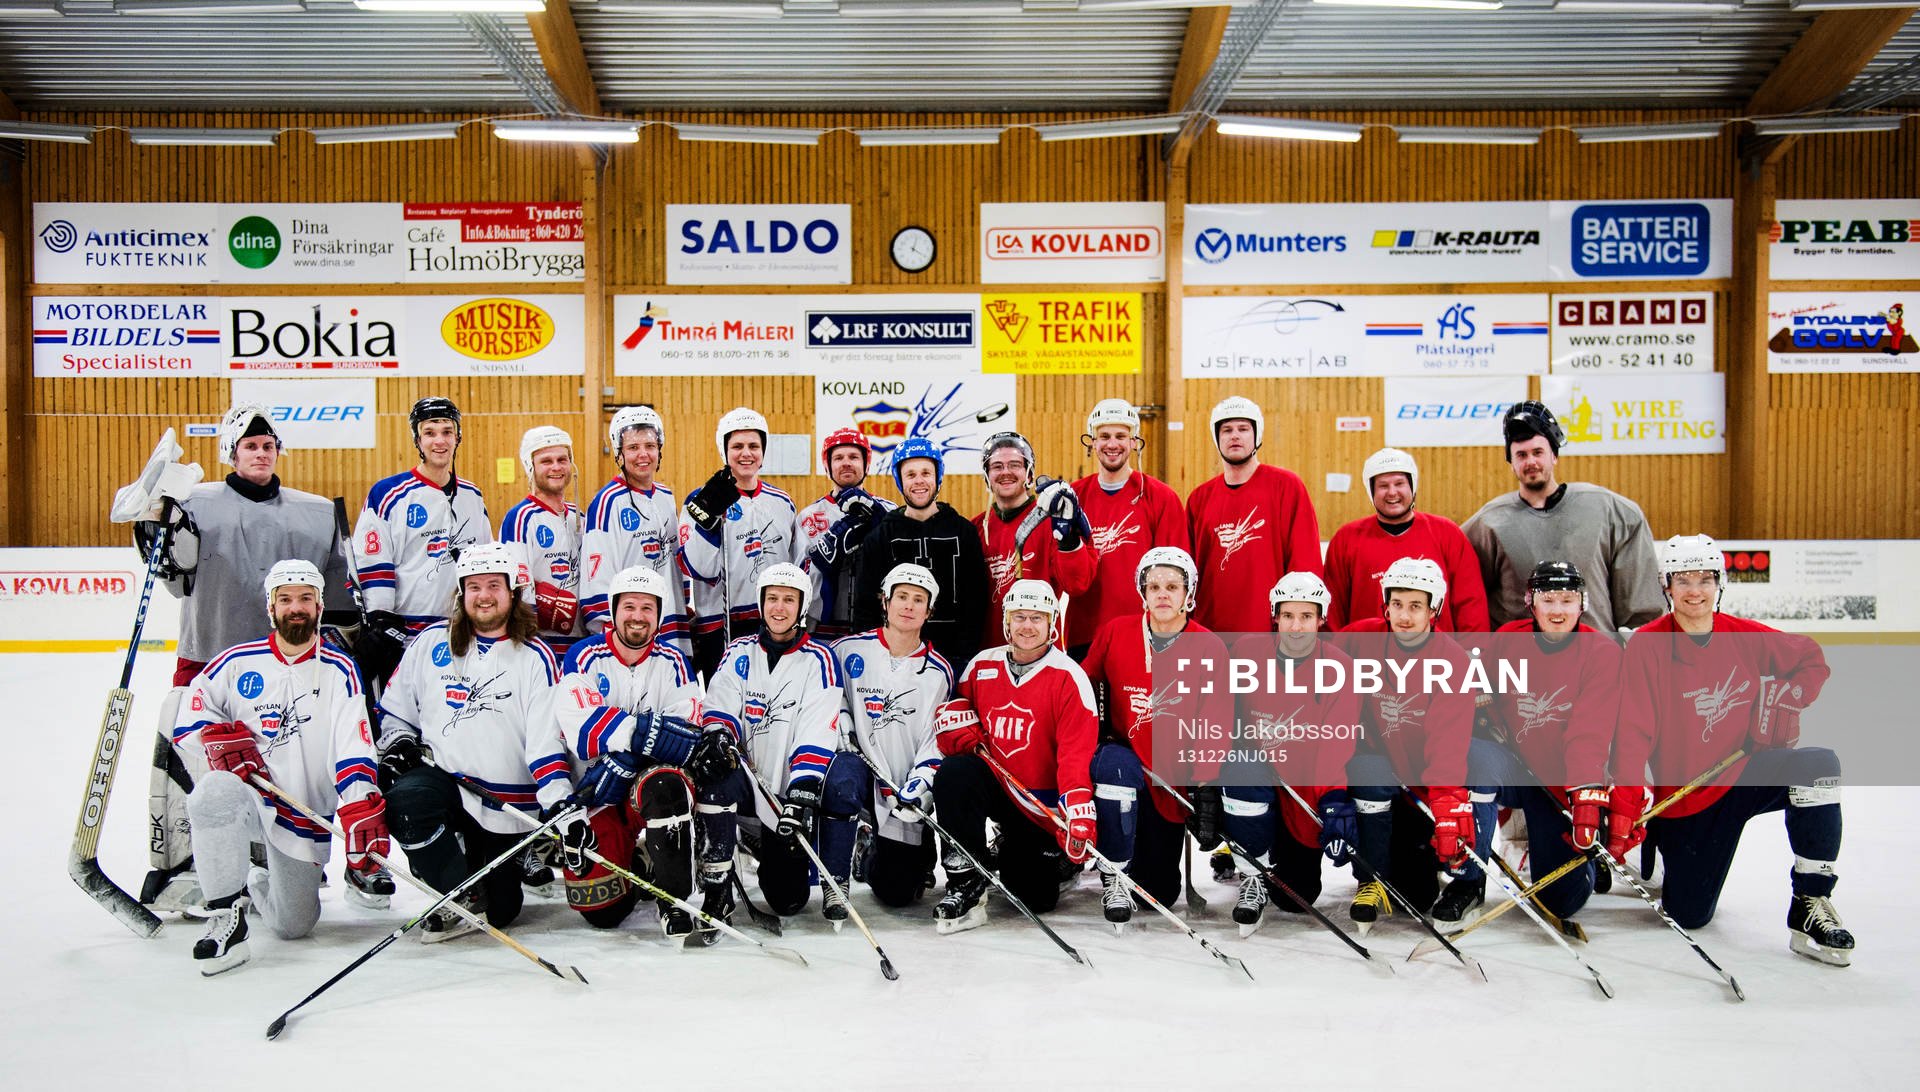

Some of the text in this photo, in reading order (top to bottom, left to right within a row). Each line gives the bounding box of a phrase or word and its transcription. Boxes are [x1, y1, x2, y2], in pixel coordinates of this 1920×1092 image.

[526, 206, 583, 222] Tynderö
[292, 219, 328, 234] Dina
[407, 226, 445, 243] Café
[536, 225, 570, 240] 060-420
[1582, 217, 1698, 240] BATTERI
[1780, 220, 1910, 243] PEAB
[85, 229, 208, 246] Anticimex
[233, 232, 276, 249] dina
[681, 219, 839, 254] SALDO
[997, 235, 1023, 249] ICA
[1031, 233, 1150, 253] KOVLAND
[1236, 233, 1347, 252] Munters
[1433, 231, 1540, 246] K-RAUTA
[292, 239, 394, 257] Försäkringar
[1581, 241, 1699, 264] SERVICE
[86, 253, 207, 266] FUKTTEKNIK
[294, 257, 355, 267] www.dina.se
[46, 304, 207, 320] MOTORDELAR
[455, 303, 542, 330] MUSIK
[1038, 301, 1131, 321] TRAFIK
[1563, 304, 1701, 322] CRAMO
[71, 327, 185, 346] BILDELS
[230, 304, 396, 358] Bokia
[842, 322, 971, 339] LRF KONSULT
[1038, 324, 1132, 343] TEKNIK
[1793, 328, 1884, 349] GOLV
[455, 330, 542, 355] BÖRSEN
[1569, 333, 1695, 347] www.cramo.se
[1416, 343, 1495, 358] Plåtslageri
[63, 353, 192, 373] Specialisten
[1238, 356, 1305, 368] FRAKT
[1316, 355, 1347, 368] AB
[1571, 354, 1602, 368] 060
[1620, 354, 1640, 368] 52
[1647, 353, 1665, 366] 41
[1673, 352, 1693, 367] 40
[822, 381, 905, 395] KOVLAND
[271, 405, 364, 421] AUER
[1611, 400, 1684, 418] WIRE
[863, 422, 897, 435] KIF
[1611, 420, 1716, 441] LIFTING
[801, 511, 829, 538] 35
[364, 530, 381, 555] 8
[589, 554, 601, 581] 7
[13, 577, 127, 596] KOVLAND
[570, 687, 604, 709] 18
[994, 716, 1025, 740] KIF
[83, 696, 128, 828] KOHO
